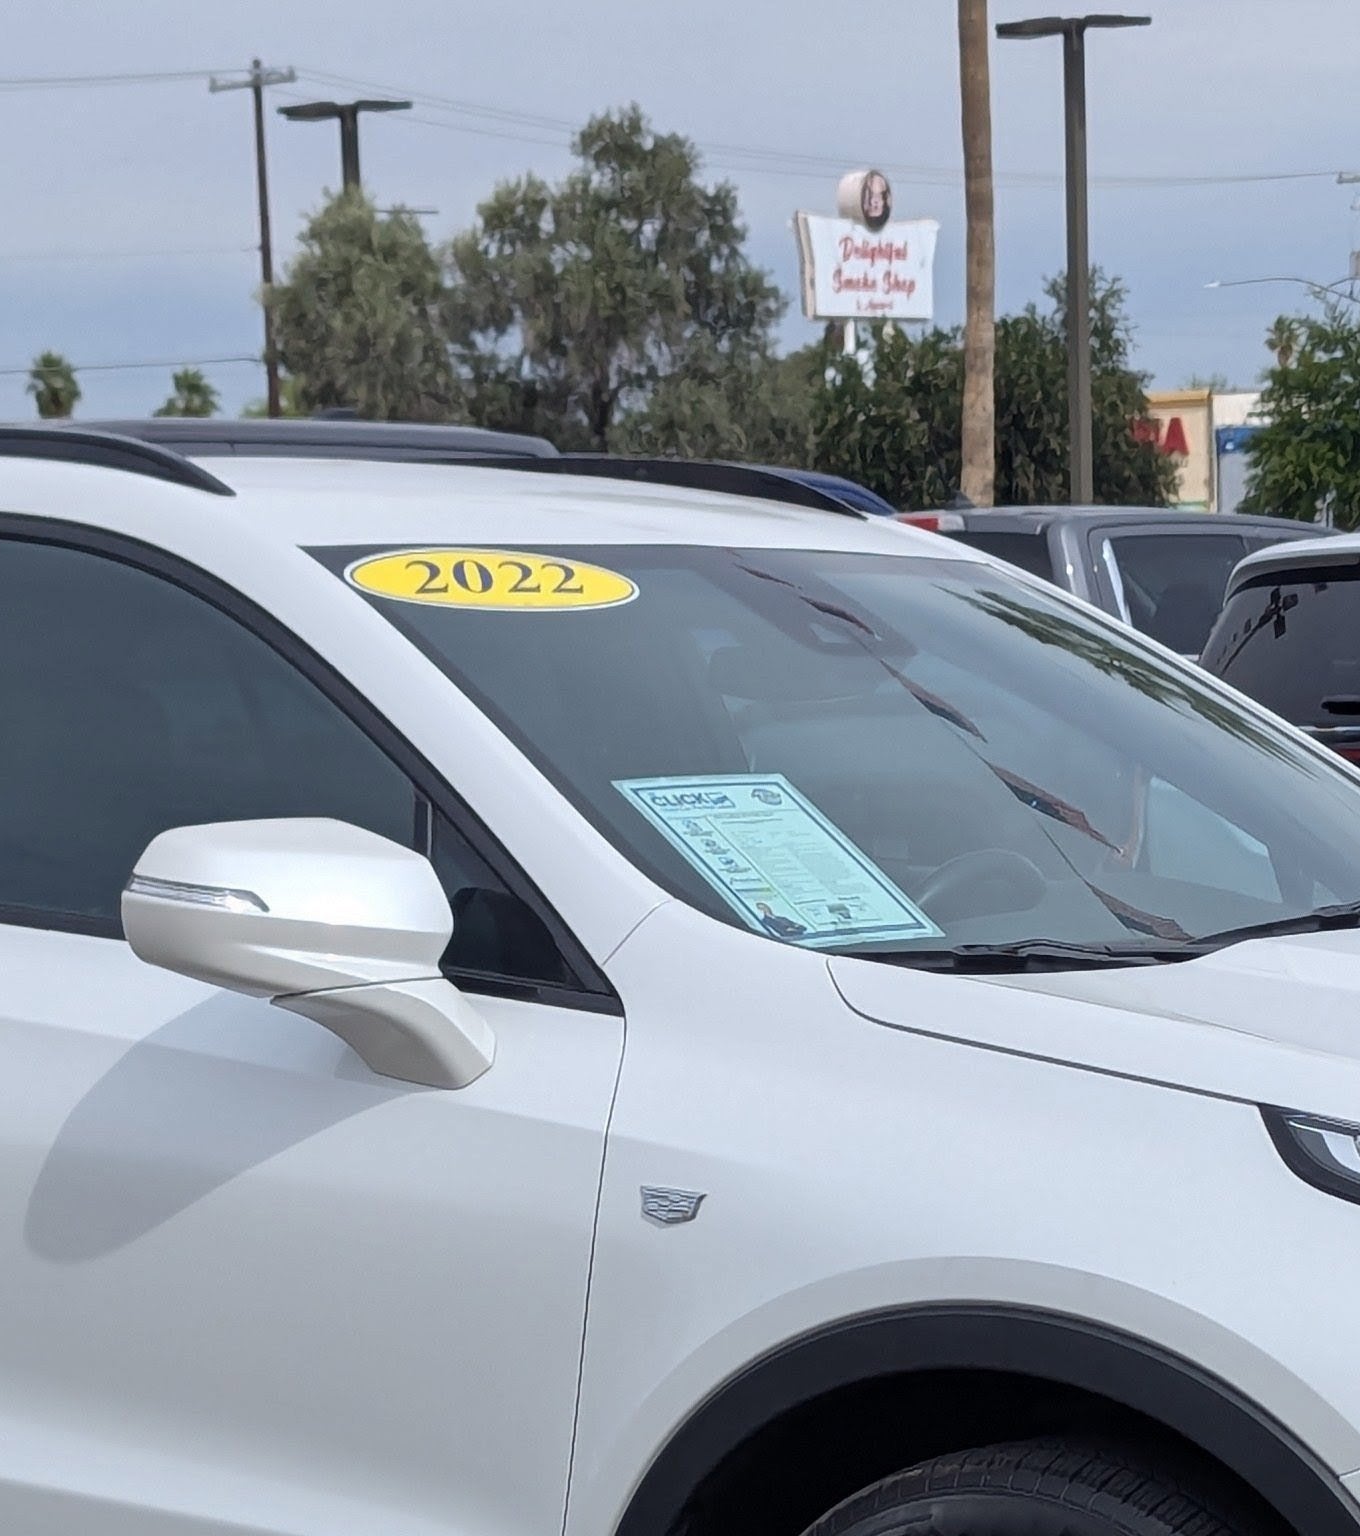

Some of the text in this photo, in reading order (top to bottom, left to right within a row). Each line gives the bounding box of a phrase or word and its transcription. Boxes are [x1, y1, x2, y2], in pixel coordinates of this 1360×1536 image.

[832, 268, 916, 300] Smoke Shop
[404, 559, 585, 595] 2022
